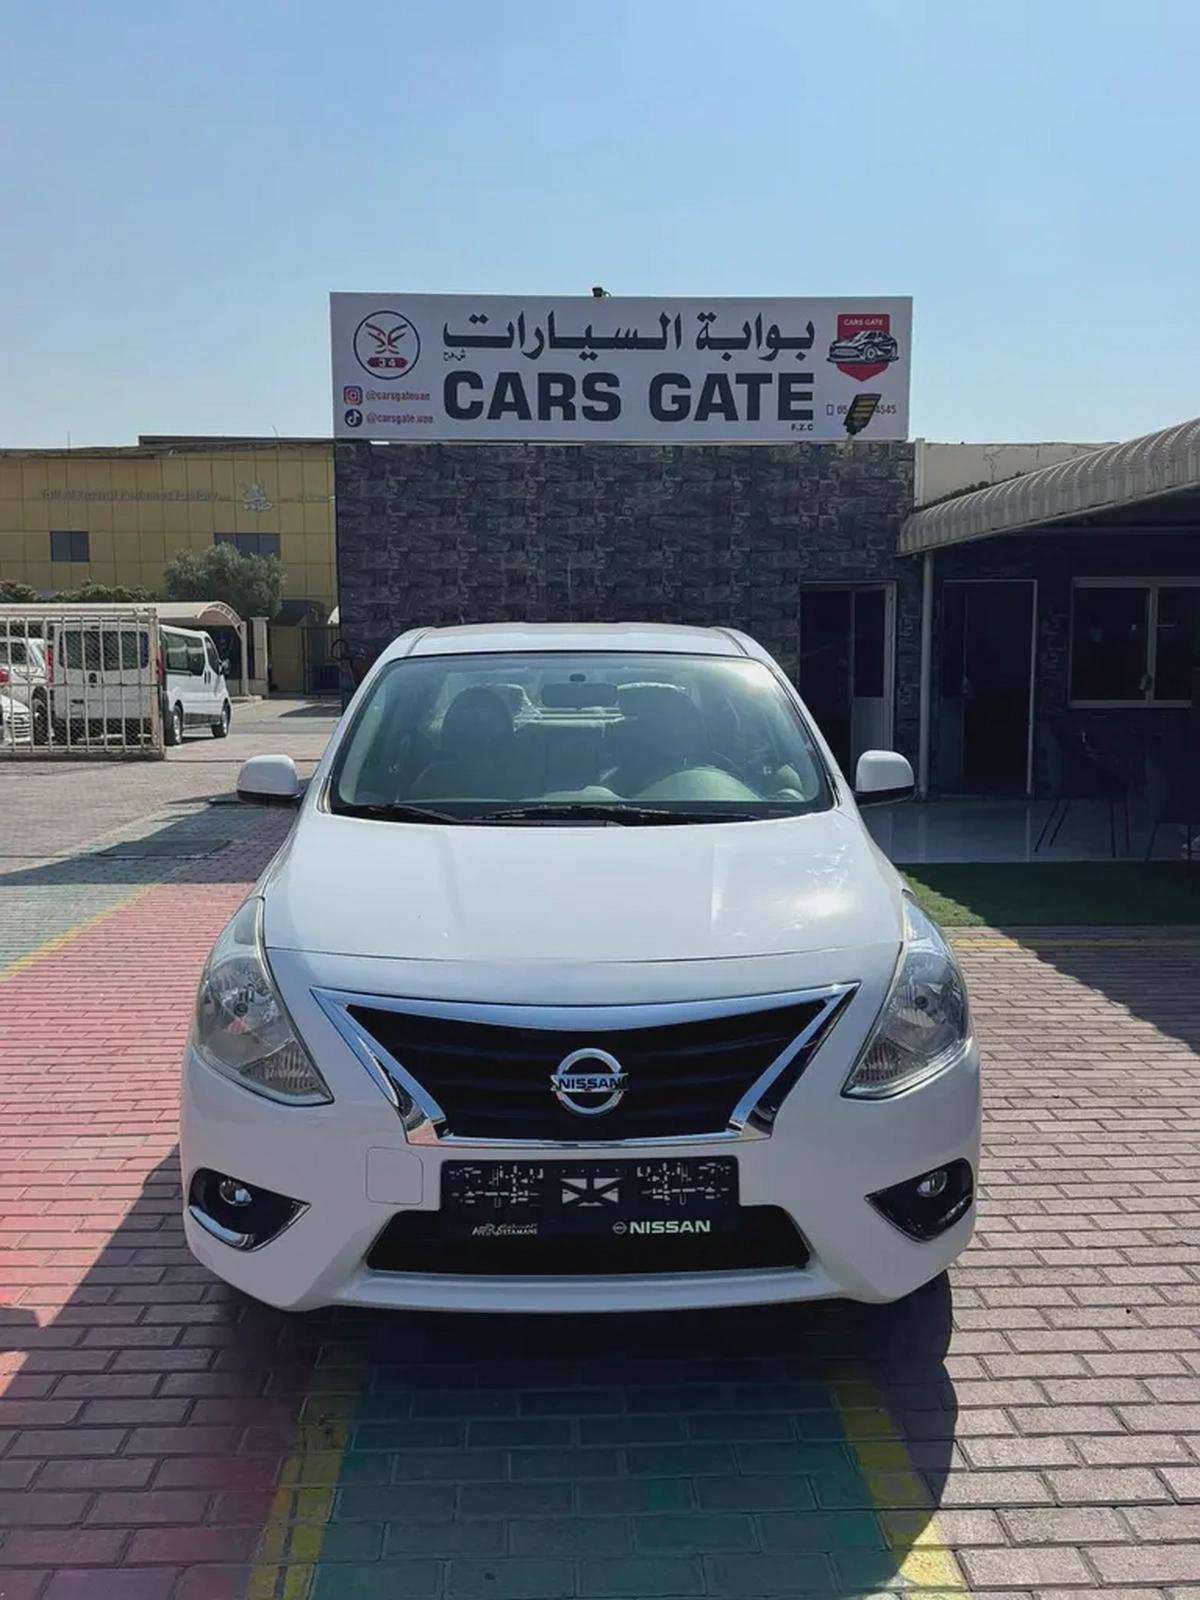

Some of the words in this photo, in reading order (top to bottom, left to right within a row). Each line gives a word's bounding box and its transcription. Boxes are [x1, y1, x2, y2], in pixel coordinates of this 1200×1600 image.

[443, 310, 682, 361] السيارات
[696, 312, 815, 361] بوابة
[843, 318, 863, 326] CARS
[864, 318, 884, 326] GATE
[443, 370, 620, 421] CARS
[649, 372, 815, 422] GATE
[559, 1077, 621, 1089] NISSAN
[629, 1220, 711, 1235] NISSAN
